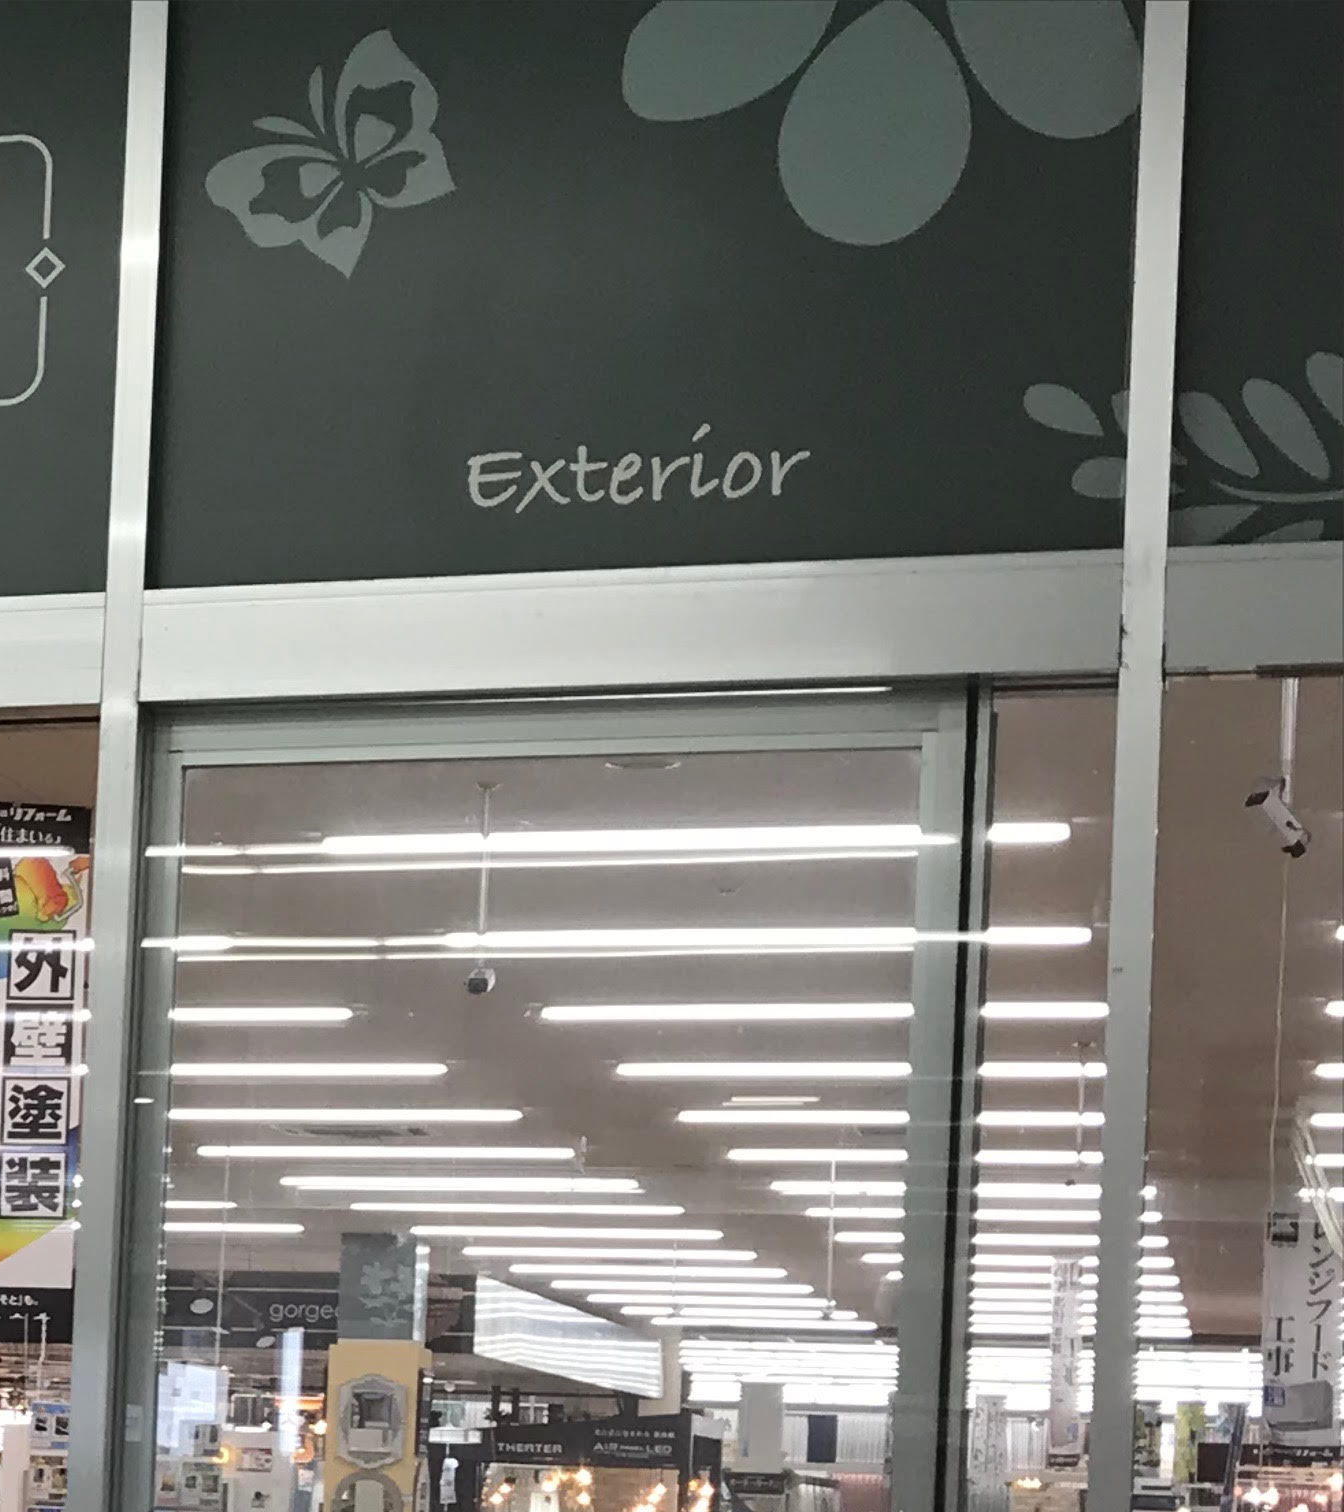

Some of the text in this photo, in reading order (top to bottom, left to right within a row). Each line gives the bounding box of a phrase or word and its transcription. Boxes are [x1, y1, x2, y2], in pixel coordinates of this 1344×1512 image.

[467, 423, 811, 517] Exterior
[9, 807, 73, 822] リフォーム
[4, 936, 69, 1213] 外壁塗装
